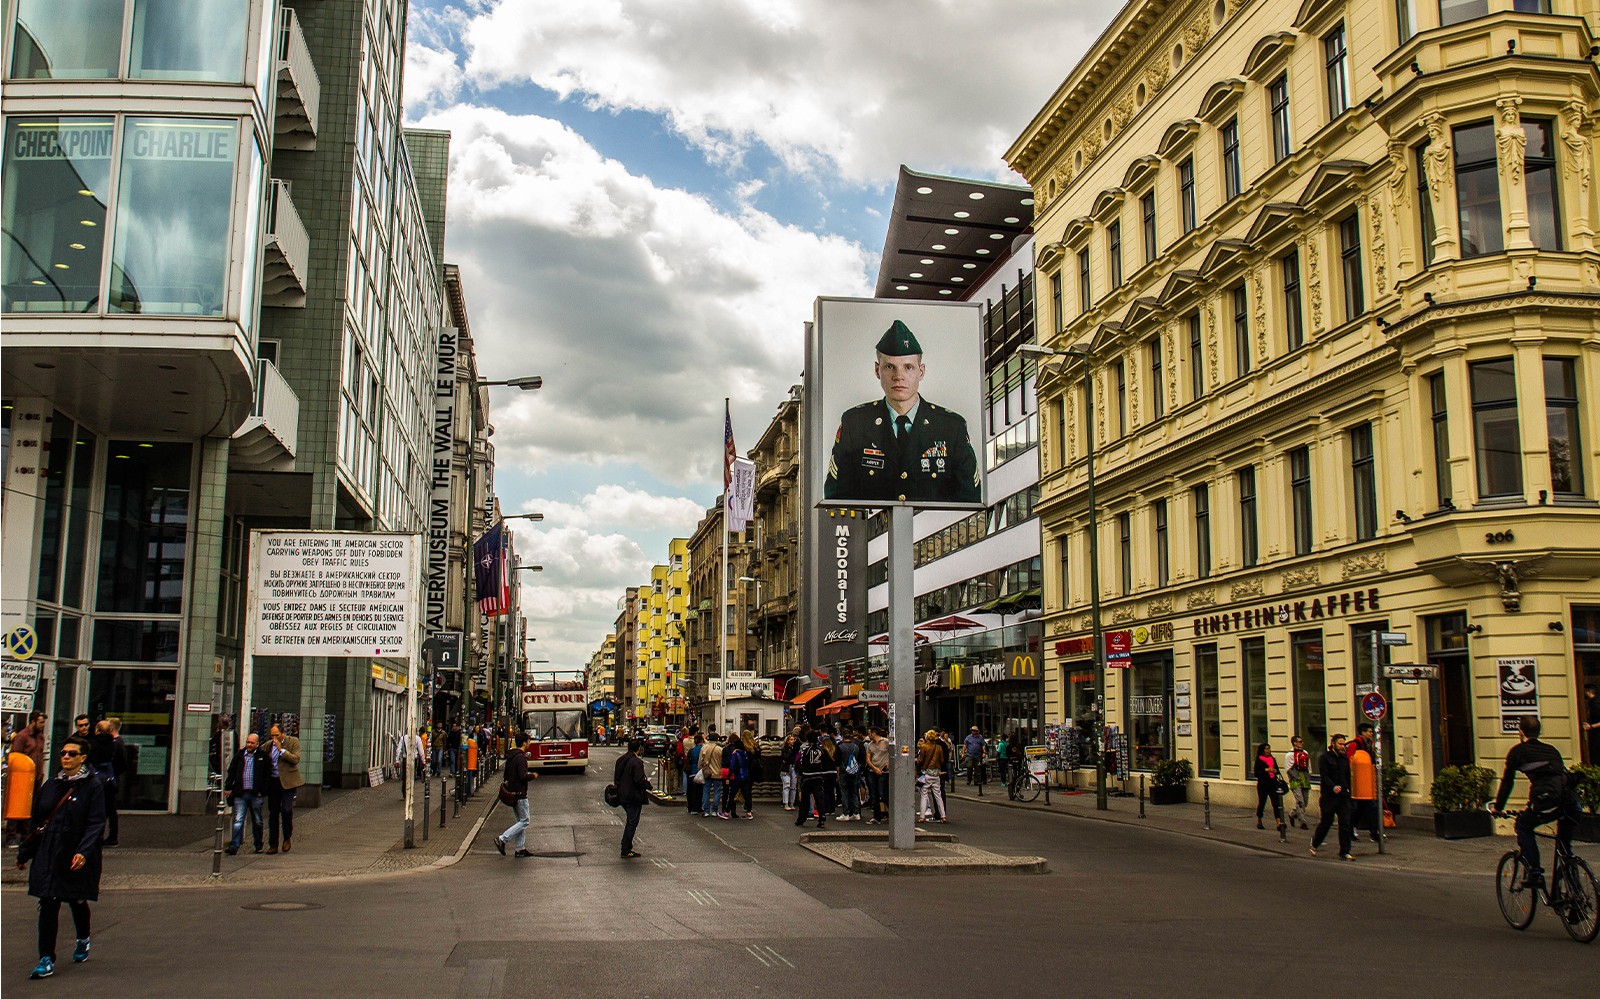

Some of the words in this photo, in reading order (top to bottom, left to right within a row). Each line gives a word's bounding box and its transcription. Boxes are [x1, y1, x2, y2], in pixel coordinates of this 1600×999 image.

[14, 130, 114, 158] CHECKPOINT
[133, 131, 229, 158] CHARLIE
[440, 333, 456, 374] MUR
[437, 379, 454, 397] LE
[434, 406, 453, 453] WALL
[433, 459, 450, 490] THE
[1485, 529, 1515, 545] 206
[268, 538, 281, 547] YOU
[284, 538, 296, 547] ARE
[299, 539, 329, 548] ENTERING
[331, 539, 342, 548] THE
[345, 539, 377, 549] AMERICAN
[379, 540, 404, 549] SECTOR
[267, 548, 300, 556] CARRYING
[302, 548, 333, 557] WEAPONS
[335, 549, 347, 557] OFF
[350, 549, 366, 558] DUTY
[368, 549, 403, 558] FORBIDDEN
[302, 558, 319, 566] OBEY
[322, 558, 348, 567] TRAFFIC
[350, 559, 369, 567] RULES
[270, 569, 281, 579] ВЫ
[378, 571, 401, 580] СЕКТОР
[835, 525, 850, 623] McDonalds
[263, 602, 281, 611] VOUS
[283, 603, 307, 611] ENTREZ
[309, 603, 327, 612] DANS
[330, 603, 336, 612] LE
[339, 603, 366, 612] SECTEUR
[1193, 606, 1275, 636] EINSTEIN
[1293, 588, 1380, 622] KAFFEE
[286, 612, 293, 621] DE
[293, 613, 313, 621] PORTER
[313, 613, 324, 621] DES
[325, 613, 342, 621] ARMES
[343, 613, 351, 621] EN
[352, 613, 373, 621] DEHORS
[383, 614, 405, 622] SERVICE
[304, 622, 317, 630] AUX
[346, 623, 354, 631] DE
[356, 623, 397, 631] CIRCULATION
[1150, 622, 1175, 643] GIFTS
[261, 635, 272, 644] SIE
[274, 635, 306, 645] BETRETEN
[307, 636, 321, 645] DEN
[322, 636, 377, 645] AMERIKANISCHEN
[379, 636, 403, 645] SEKTOR
[9, 680, 23, 688] frei
[712, 682, 721, 691] US
[523, 694, 550, 704] CITY
[552, 694, 585, 704] TOUR
[810, 748, 822, 765] 12
